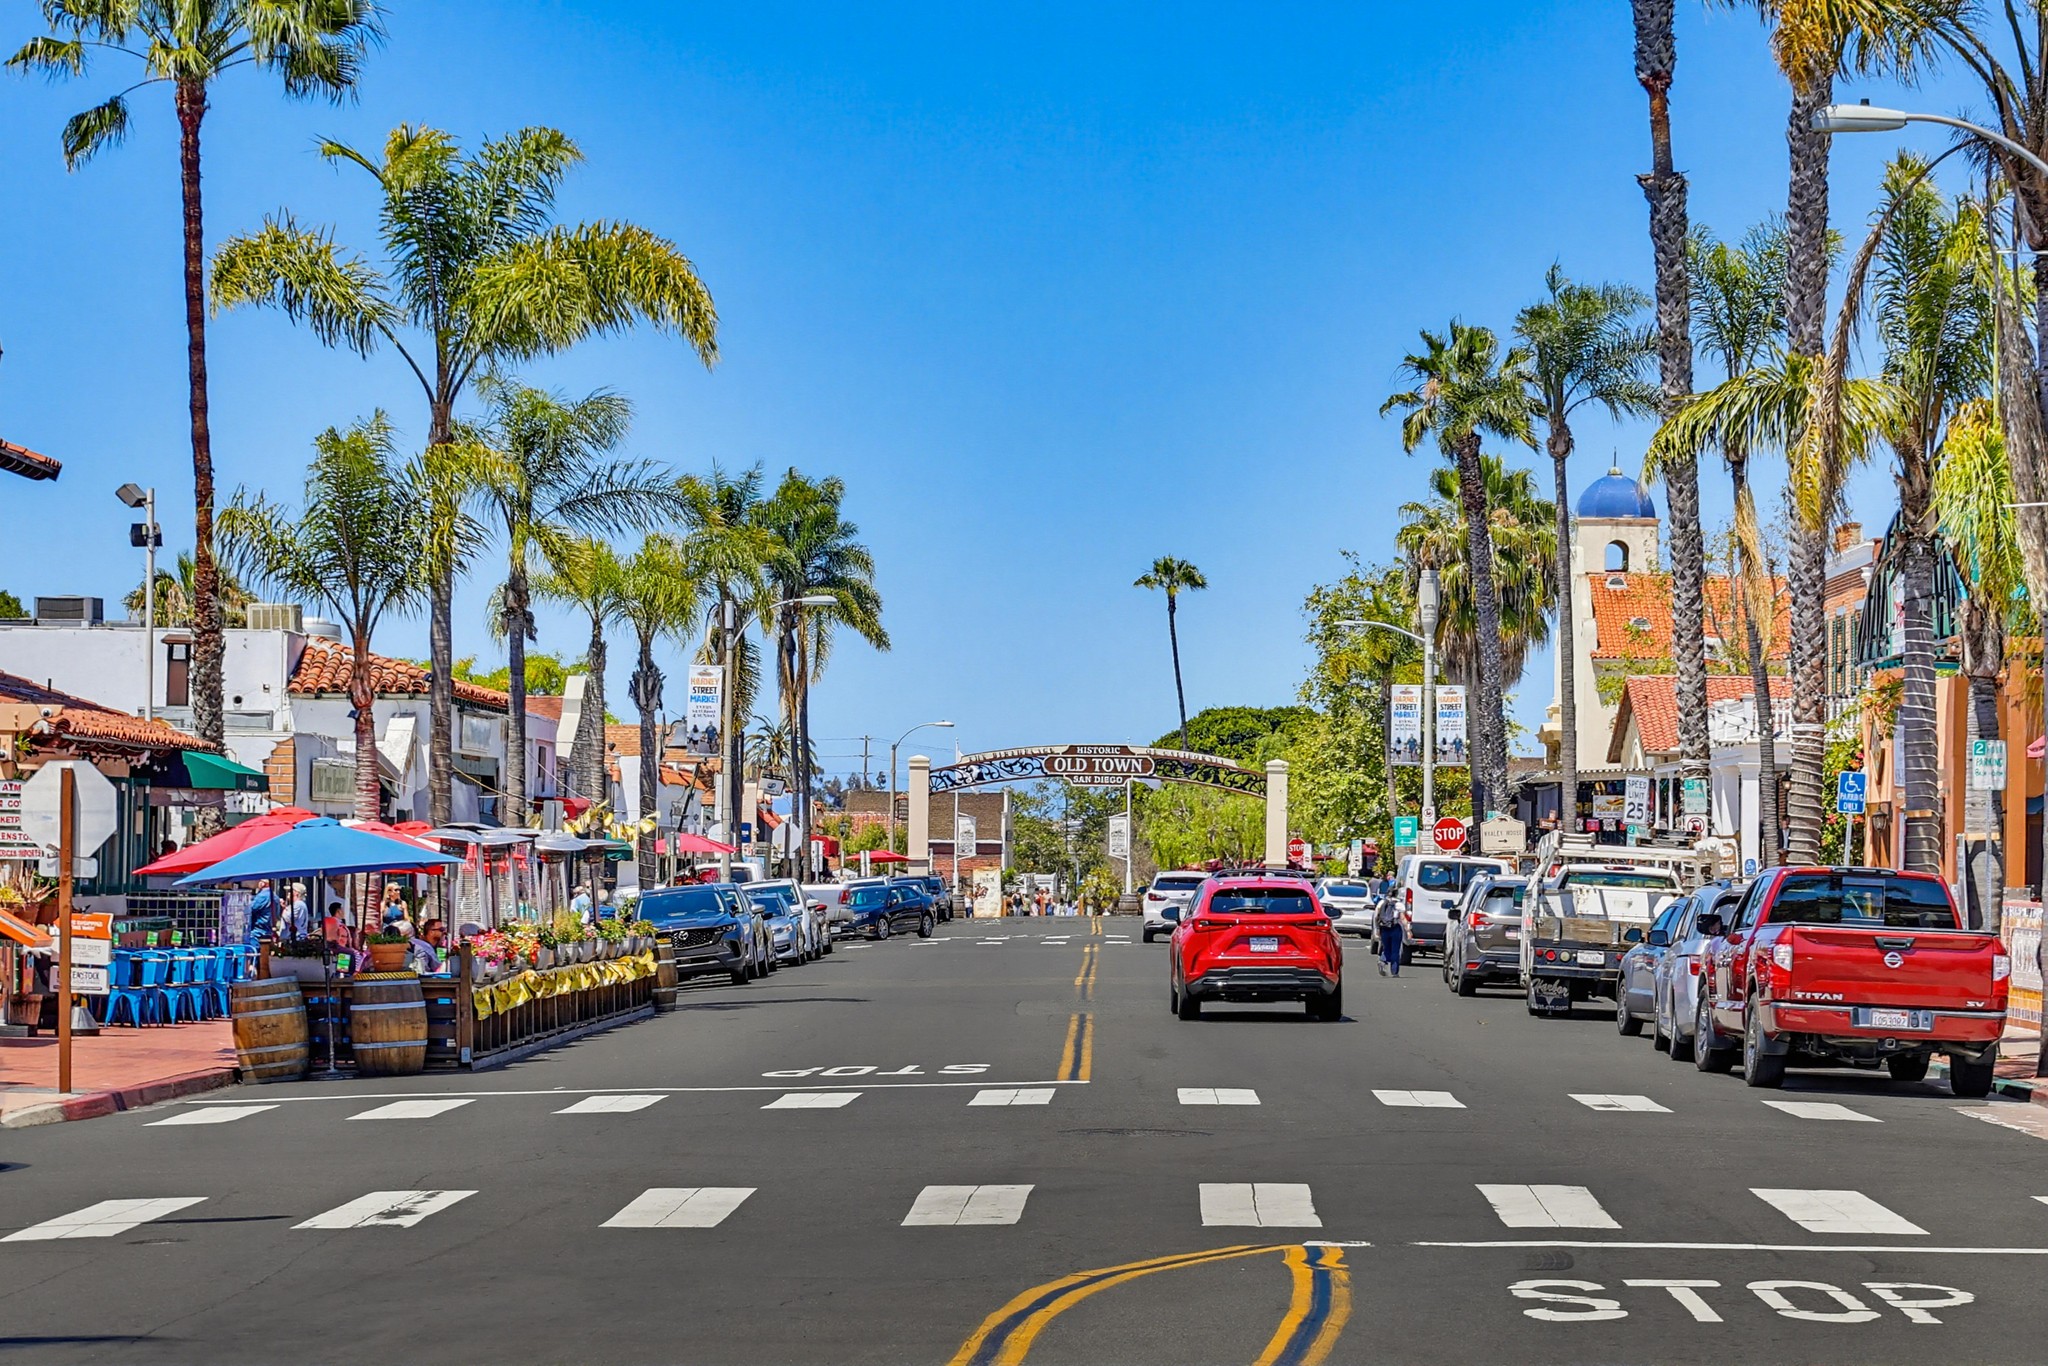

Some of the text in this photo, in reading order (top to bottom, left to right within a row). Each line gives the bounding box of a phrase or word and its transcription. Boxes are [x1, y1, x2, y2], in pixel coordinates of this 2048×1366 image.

[692, 686, 718, 694] STREET
[690, 695, 719, 703] MARKET
[1395, 703, 1417, 711] STREET
[1440, 703, 1462, 711] STREET
[1076, 746, 1120, 755] HISTORIC
[1053, 757, 1143, 773] OLD TOWN
[1072, 775, 1123, 784] SAN DIEGO
[1627, 779, 1647, 789] SPEED
[1628, 791, 1645, 800] LIMIT
[1626, 801, 1644, 820] 25
[1435, 827, 1464, 841] STOP
[1289, 844, 1304, 852] STOP
[1794, 991, 1843, 1001] TITAN
[761, 1063, 991, 1078] STOP
[1507, 1279, 1975, 1323] STOP
